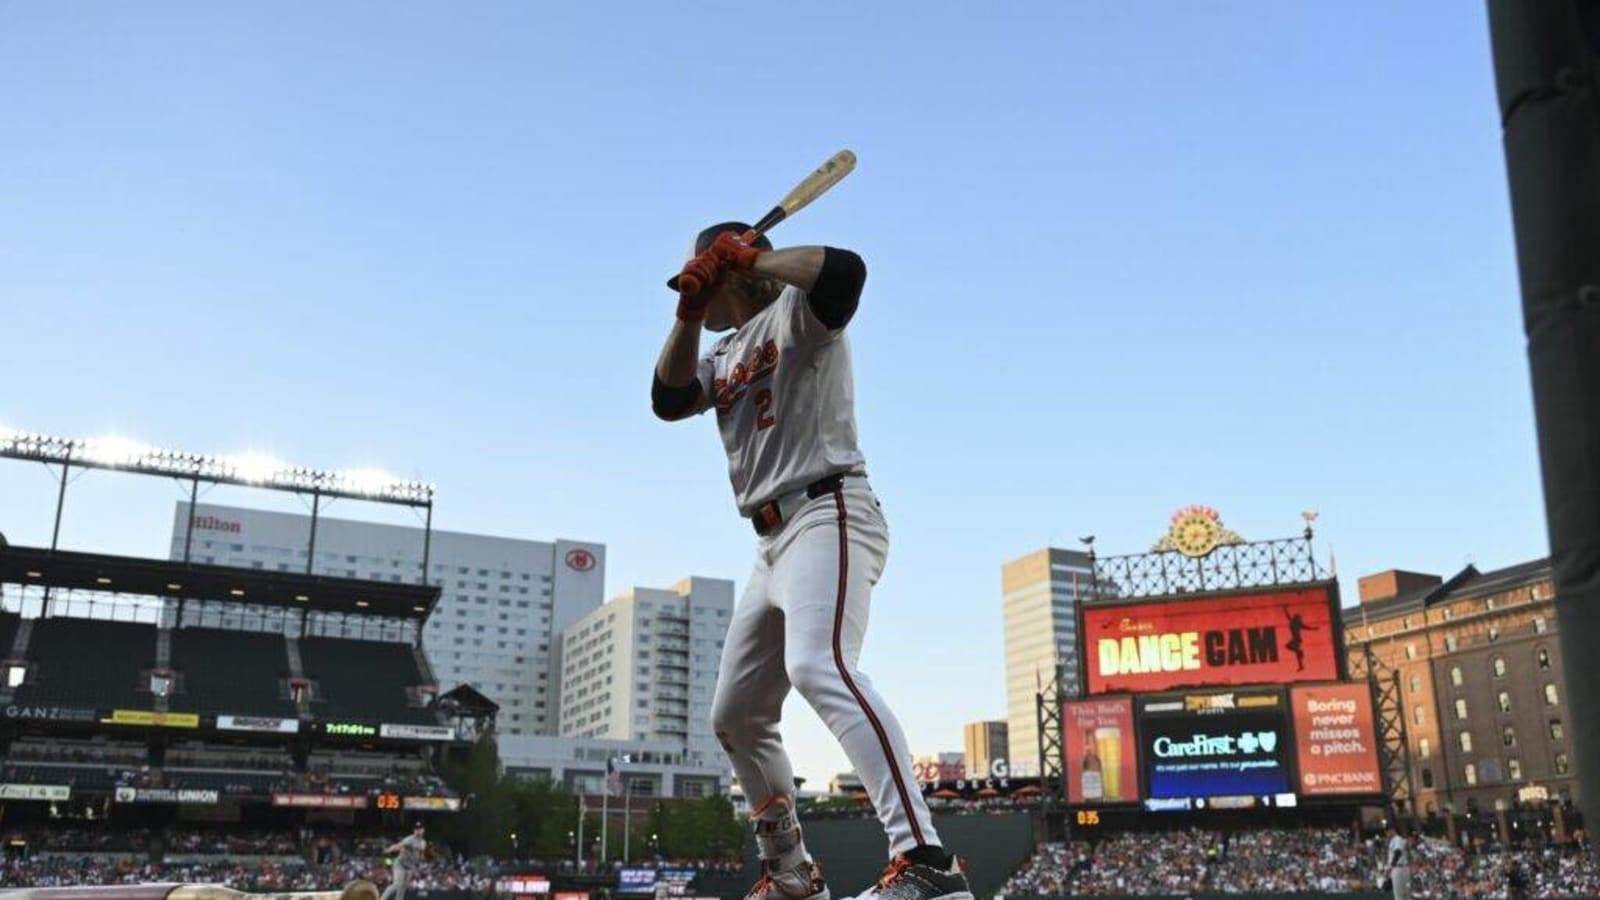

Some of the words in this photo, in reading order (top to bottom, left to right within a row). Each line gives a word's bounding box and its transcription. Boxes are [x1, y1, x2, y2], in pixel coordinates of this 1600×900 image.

[755, 388, 775, 431] 2
[1098, 631, 1201, 677] DANCE
[1204, 626, 1280, 668] CAM
[6, 705, 59, 719] GANZ
[1307, 700, 1356, 713] Boring
[1312, 715, 1354, 726] never
[1310, 728, 1360, 741] misses
[1310, 745, 1321, 754] a
[1324, 741, 1366, 757] pitch.
[178, 790, 218, 803] UNION
